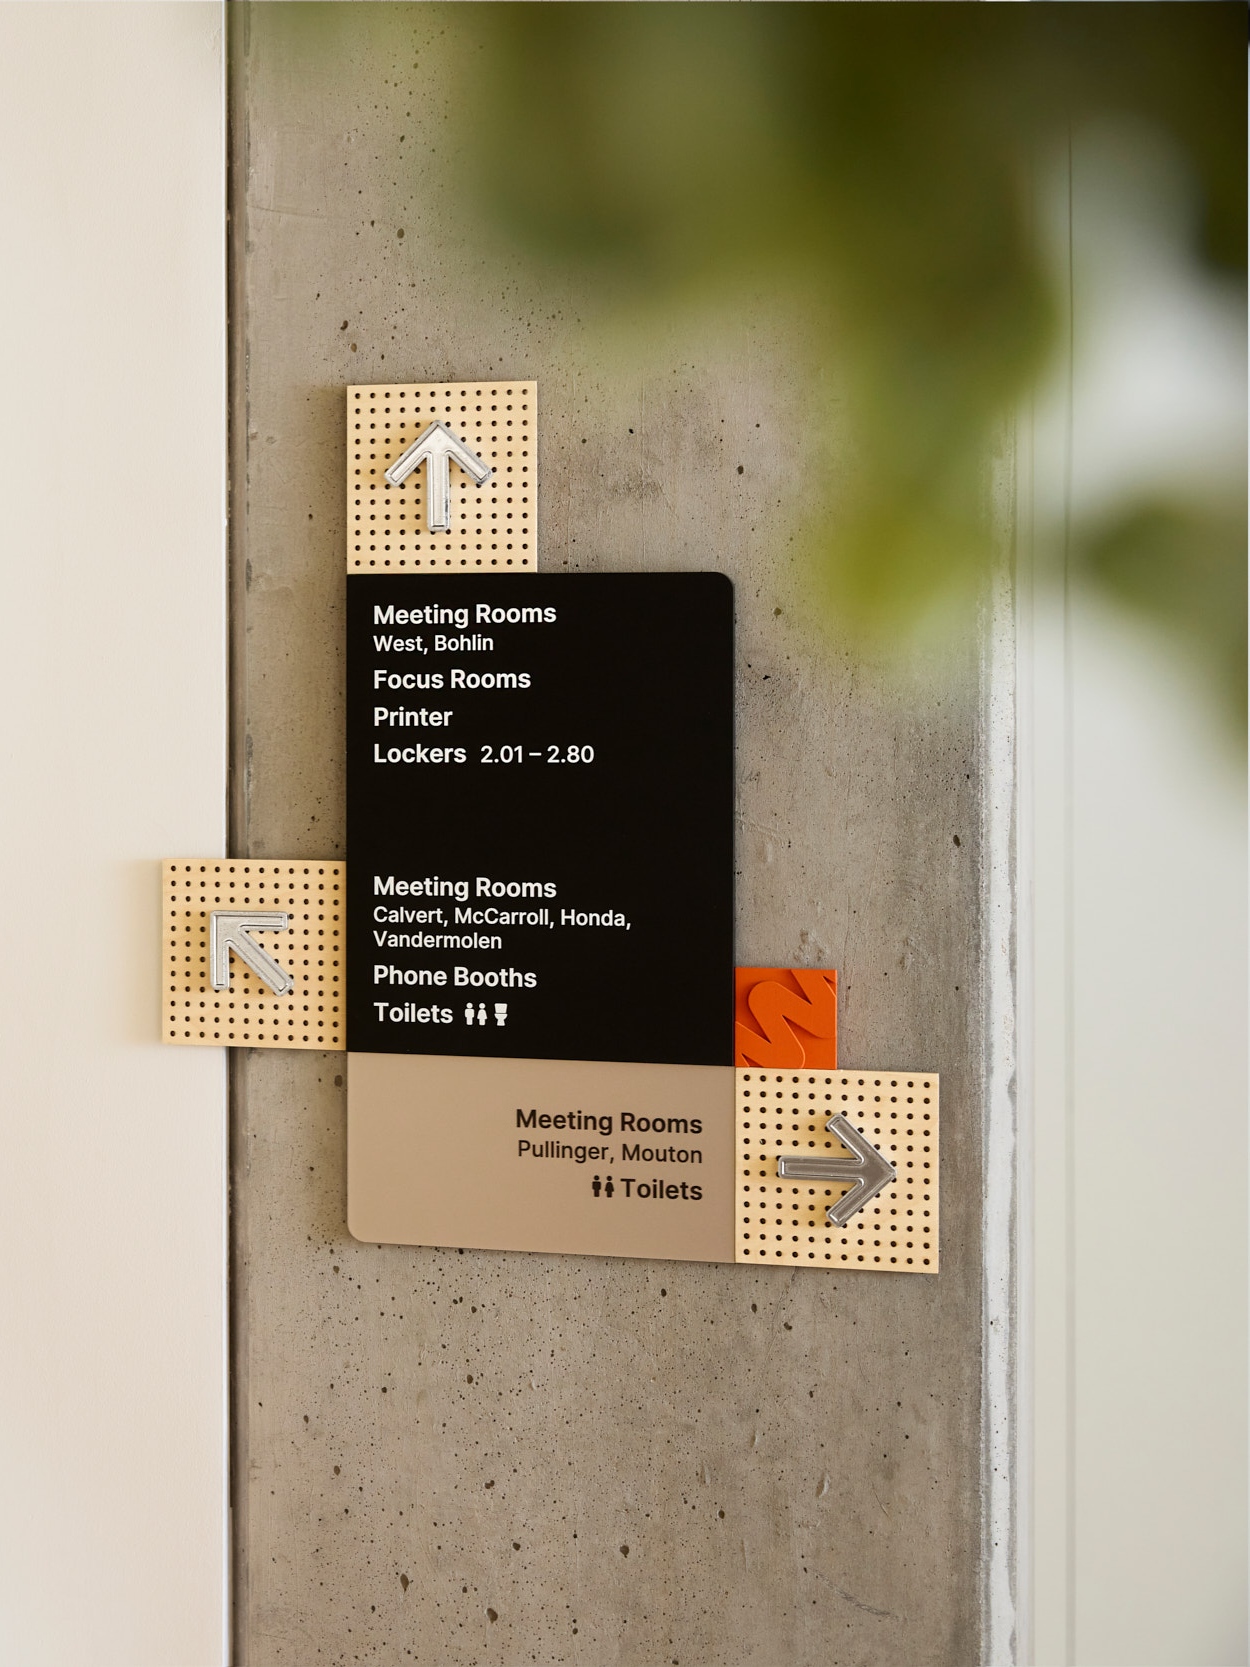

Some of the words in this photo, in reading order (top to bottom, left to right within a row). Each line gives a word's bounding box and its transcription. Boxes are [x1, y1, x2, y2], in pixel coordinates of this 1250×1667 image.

[374, 604, 468, 628] Meeting
[476, 604, 556, 623] Rooms
[373, 635, 428, 654] West,
[435, 634, 493, 651] Bohlin
[374, 670, 444, 689] Focus
[451, 669, 531, 688] Rooms
[374, 706, 453, 726] Printer
[375, 744, 466, 763] Lockers
[374, 876, 468, 901] Meeting
[476, 877, 556, 898] Rooms
[374, 906, 448, 927] Calvert,
[455, 907, 554, 929] McCarroll,
[561, 909, 630, 930] Honda,
[373, 931, 501, 949] Vandermolen
[374, 965, 447, 985] Phone
[454, 967, 537, 987] Booths
[374, 1002, 453, 1023] Toilets
[517, 1109, 612, 1136] Meeting
[621, 1113, 702, 1134] Rooms
[519, 1140, 614, 1164] Pullinger,
[623, 1144, 702, 1163] Mouton
[620, 1178, 702, 1200] Toilets
